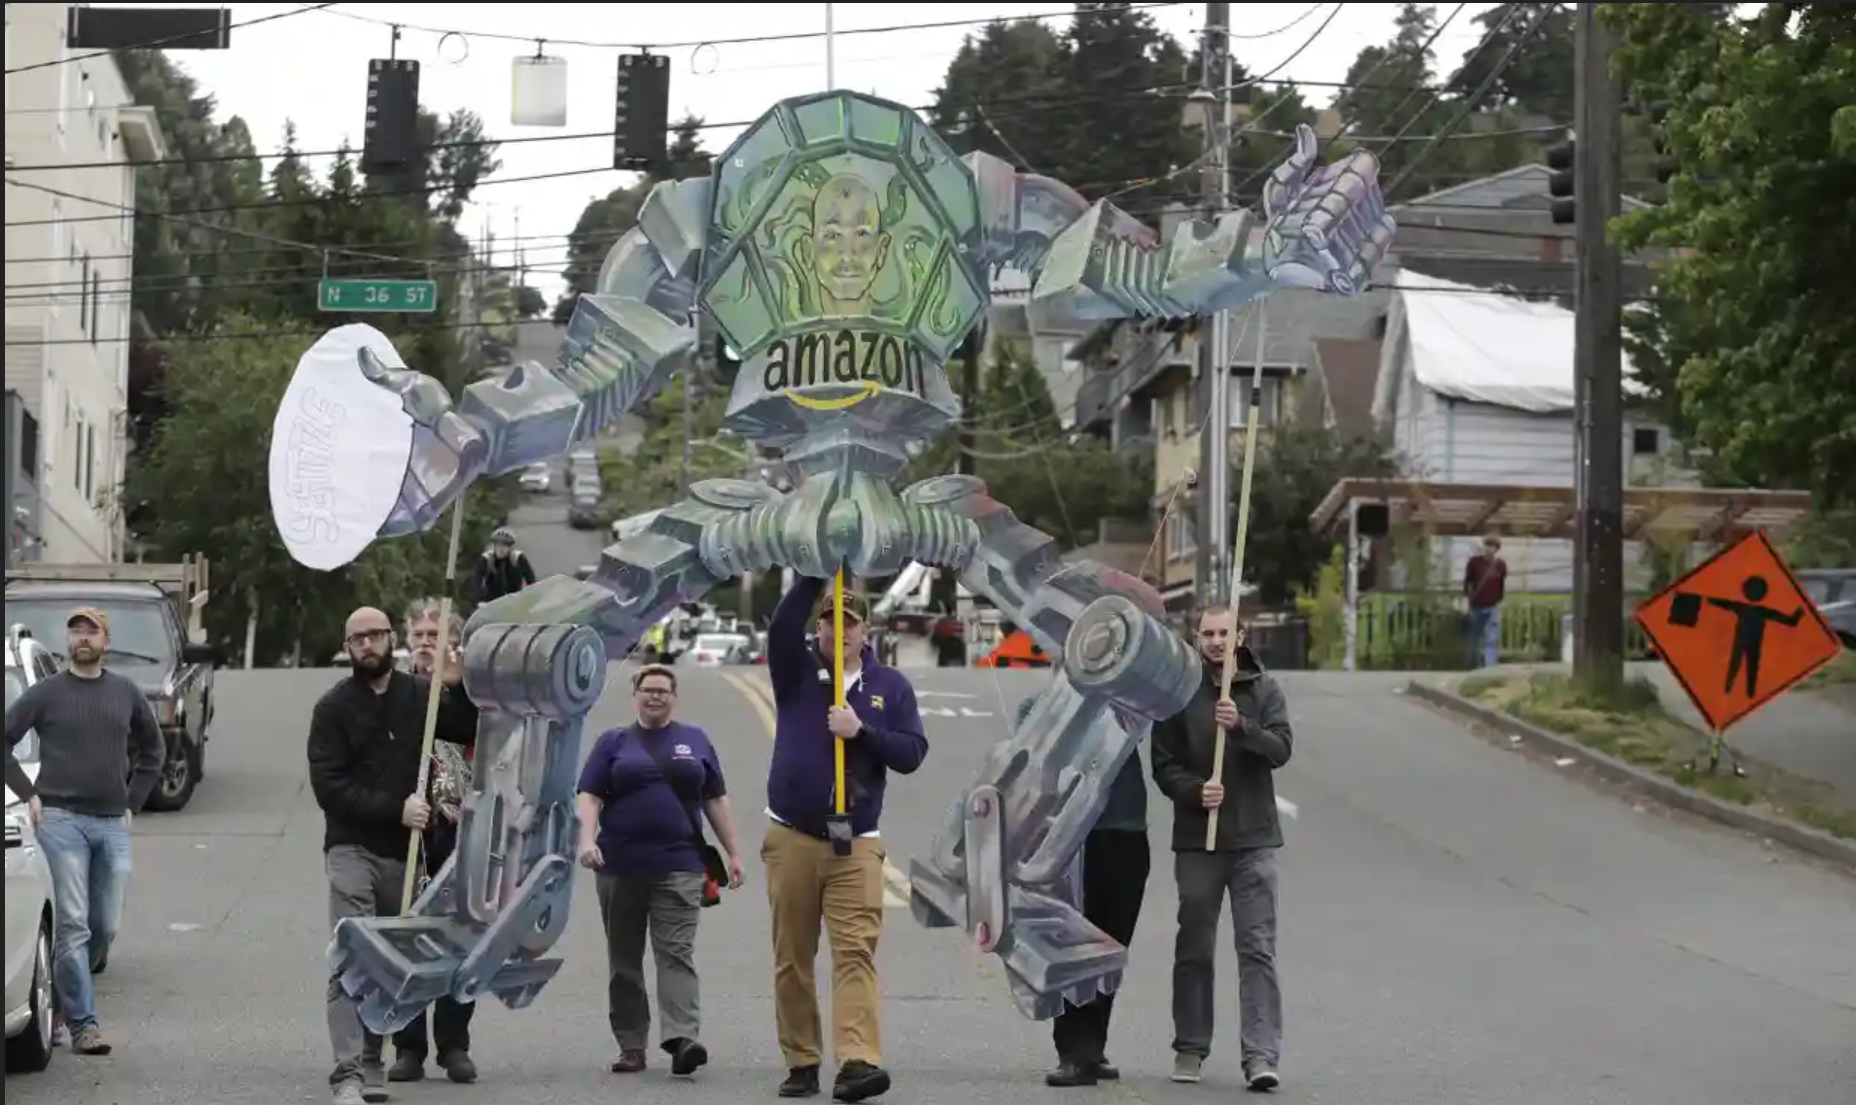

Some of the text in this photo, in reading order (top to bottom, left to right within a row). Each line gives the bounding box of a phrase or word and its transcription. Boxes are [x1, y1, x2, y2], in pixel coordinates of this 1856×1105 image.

[328, 286, 427, 304] N 36 ST
[763, 328, 926, 398] amazon
